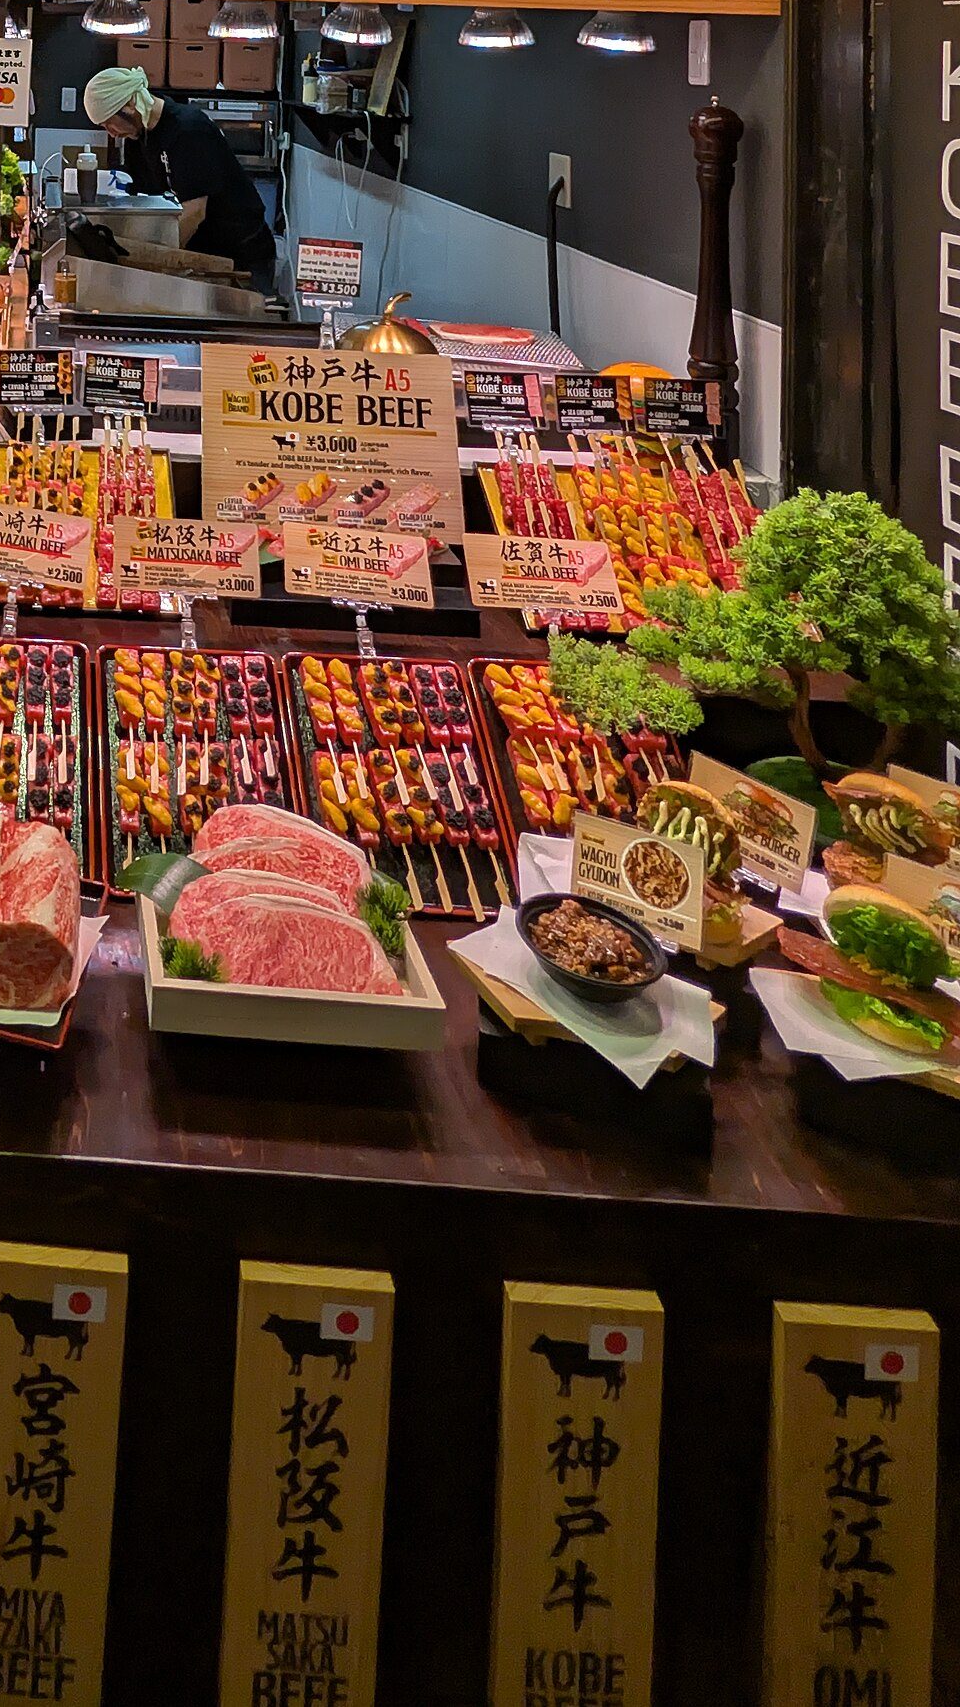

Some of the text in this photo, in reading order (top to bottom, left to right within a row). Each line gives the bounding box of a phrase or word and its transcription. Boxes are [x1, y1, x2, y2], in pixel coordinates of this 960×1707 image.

[9, 362, 33, 373] KOBE
[96, 366, 143, 379] KOBE BEEF
[253, 371, 275, 385] No.1
[283, 354, 411, 392] 神戸牛 A5
[475, 374, 503, 384] 神戸牛
[476, 384, 524, 395] KOBE BEEF
[566, 387, 614, 399] KOBE BEEF
[655, 390, 704, 403] KOBE BEEF
[258, 389, 345, 425] KOBE
[356, 395, 434, 430] BEEF
[306, 434, 358, 454] ¥3,000
[46, 522, 64, 539] A5
[152, 522, 235, 548] 松阪牛 A5
[40, 539, 67, 555] BEEF
[147, 546, 242, 565] MATSUSAKA BEEF
[322, 531, 404, 560] 近江牛 A5
[501, 539, 584, 566] 佐賀牛 A5
[47, 567, 83, 584] ¥2,500
[339, 556, 390, 572] OMI BEEF
[519, 564, 579, 580] SAGA BEEF
[218, 578, 255, 592] ¥3,000
[391, 586, 429, 603] ¥3,000
[579, 593, 618, 608] ¥2,500
[580, 842, 617, 870] WAGYU
[760, 833, 801, 866] BURGER
[578, 861, 621, 889] GYUDON
[0, 1363, 81, 1581] 宮崎牛
[270, 1387, 351, 1603] 松阪牛
[542, 1415, 622, 1634] 神戸牛
[819, 1434, 897, 1654] 近江牛
[256, 1610, 350, 1647] MATSU
[266, 1641, 337, 1674] SAKA
[523, 1647, 626, 1695] KOBE
[251, 1671, 349, 1707] BEEF
[811, 1665, 893, 1707] OMI
